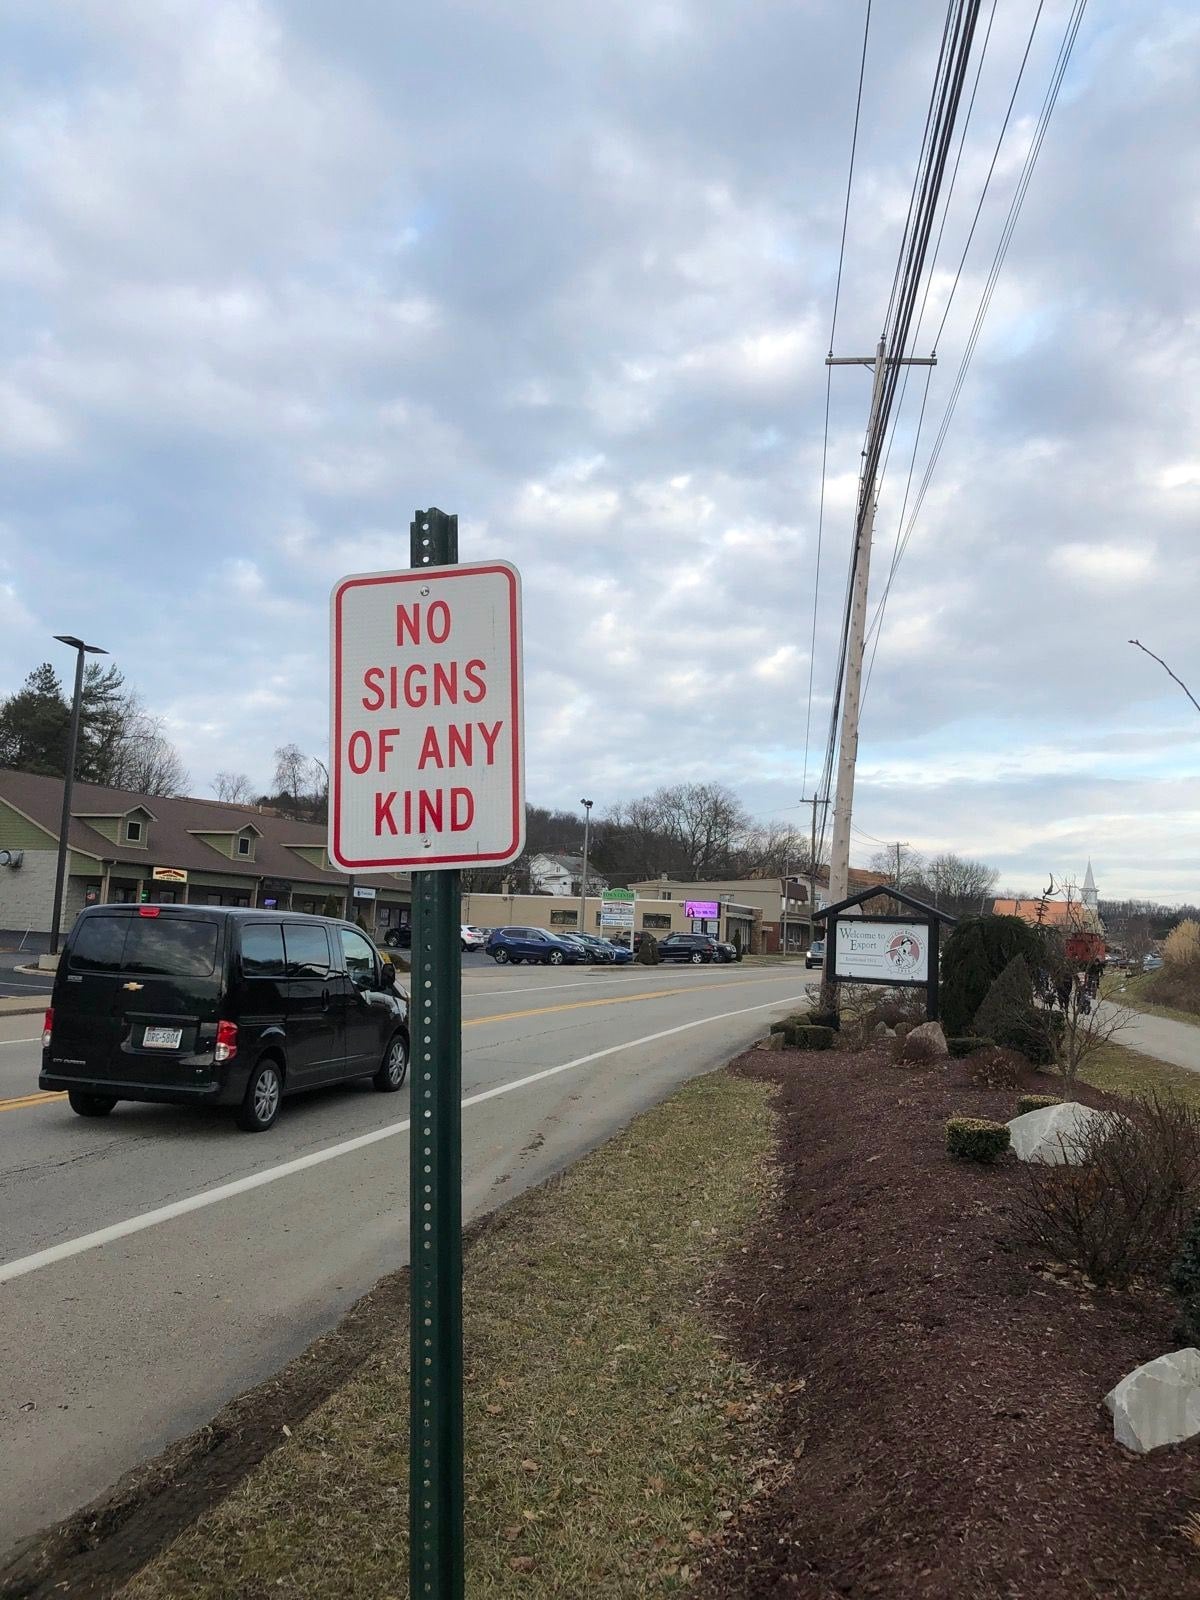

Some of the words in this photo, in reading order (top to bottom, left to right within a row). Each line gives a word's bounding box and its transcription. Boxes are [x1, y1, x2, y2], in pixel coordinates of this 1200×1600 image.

[397, 600, 451, 646] NO
[362, 660, 486, 711] SIGNS
[348, 729, 400, 775] OF
[418, 722, 502, 768] ANY
[375, 787, 474, 836] KIND
[840, 927, 877, 940] Welcome
[850, 939, 877, 951] Export
